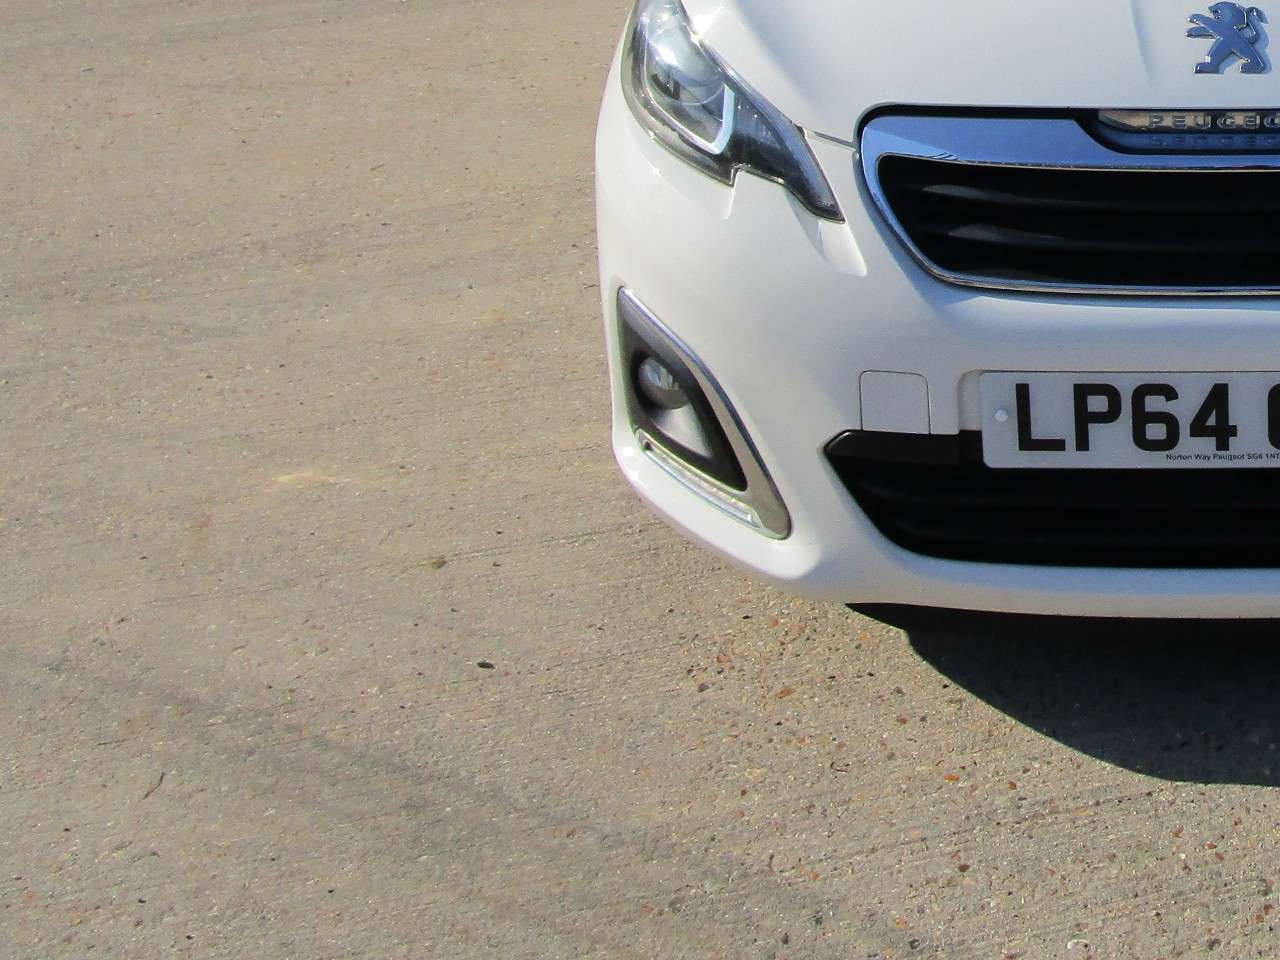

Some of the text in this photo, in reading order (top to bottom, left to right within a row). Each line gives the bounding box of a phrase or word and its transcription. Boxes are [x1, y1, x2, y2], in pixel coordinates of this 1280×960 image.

[1014, 382, 1239, 452] LP64
[1166, 453, 1193, 461] Norton
[1195, 453, 1211, 461] Way
[1213, 453, 1245, 461] Peugeot
[1265, 452, 1280, 460] 1NT
